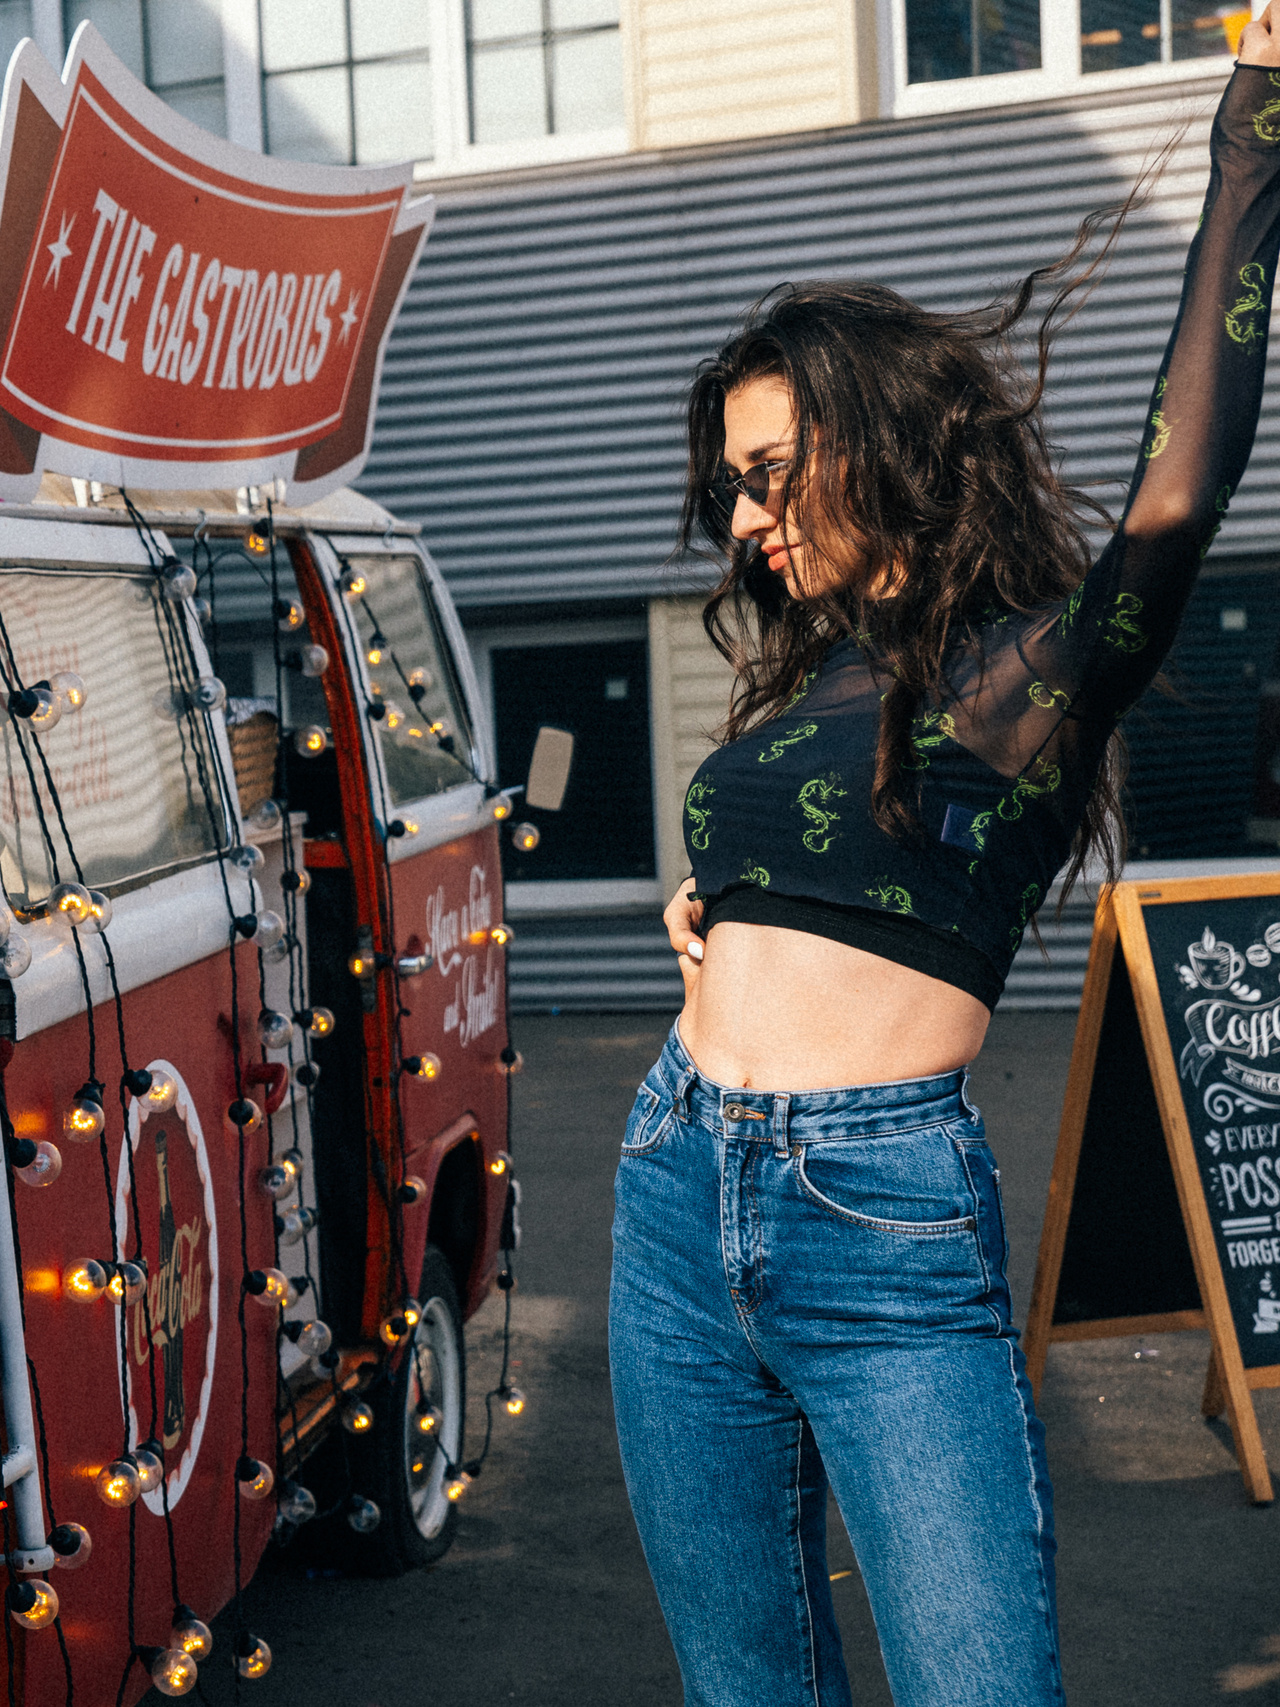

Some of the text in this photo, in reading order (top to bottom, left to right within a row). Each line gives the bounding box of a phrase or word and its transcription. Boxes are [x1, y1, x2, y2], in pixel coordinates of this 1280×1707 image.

[65, 187, 342, 391] THE GASTROBUS
[1224, 1123, 1280, 1152] EVERY
